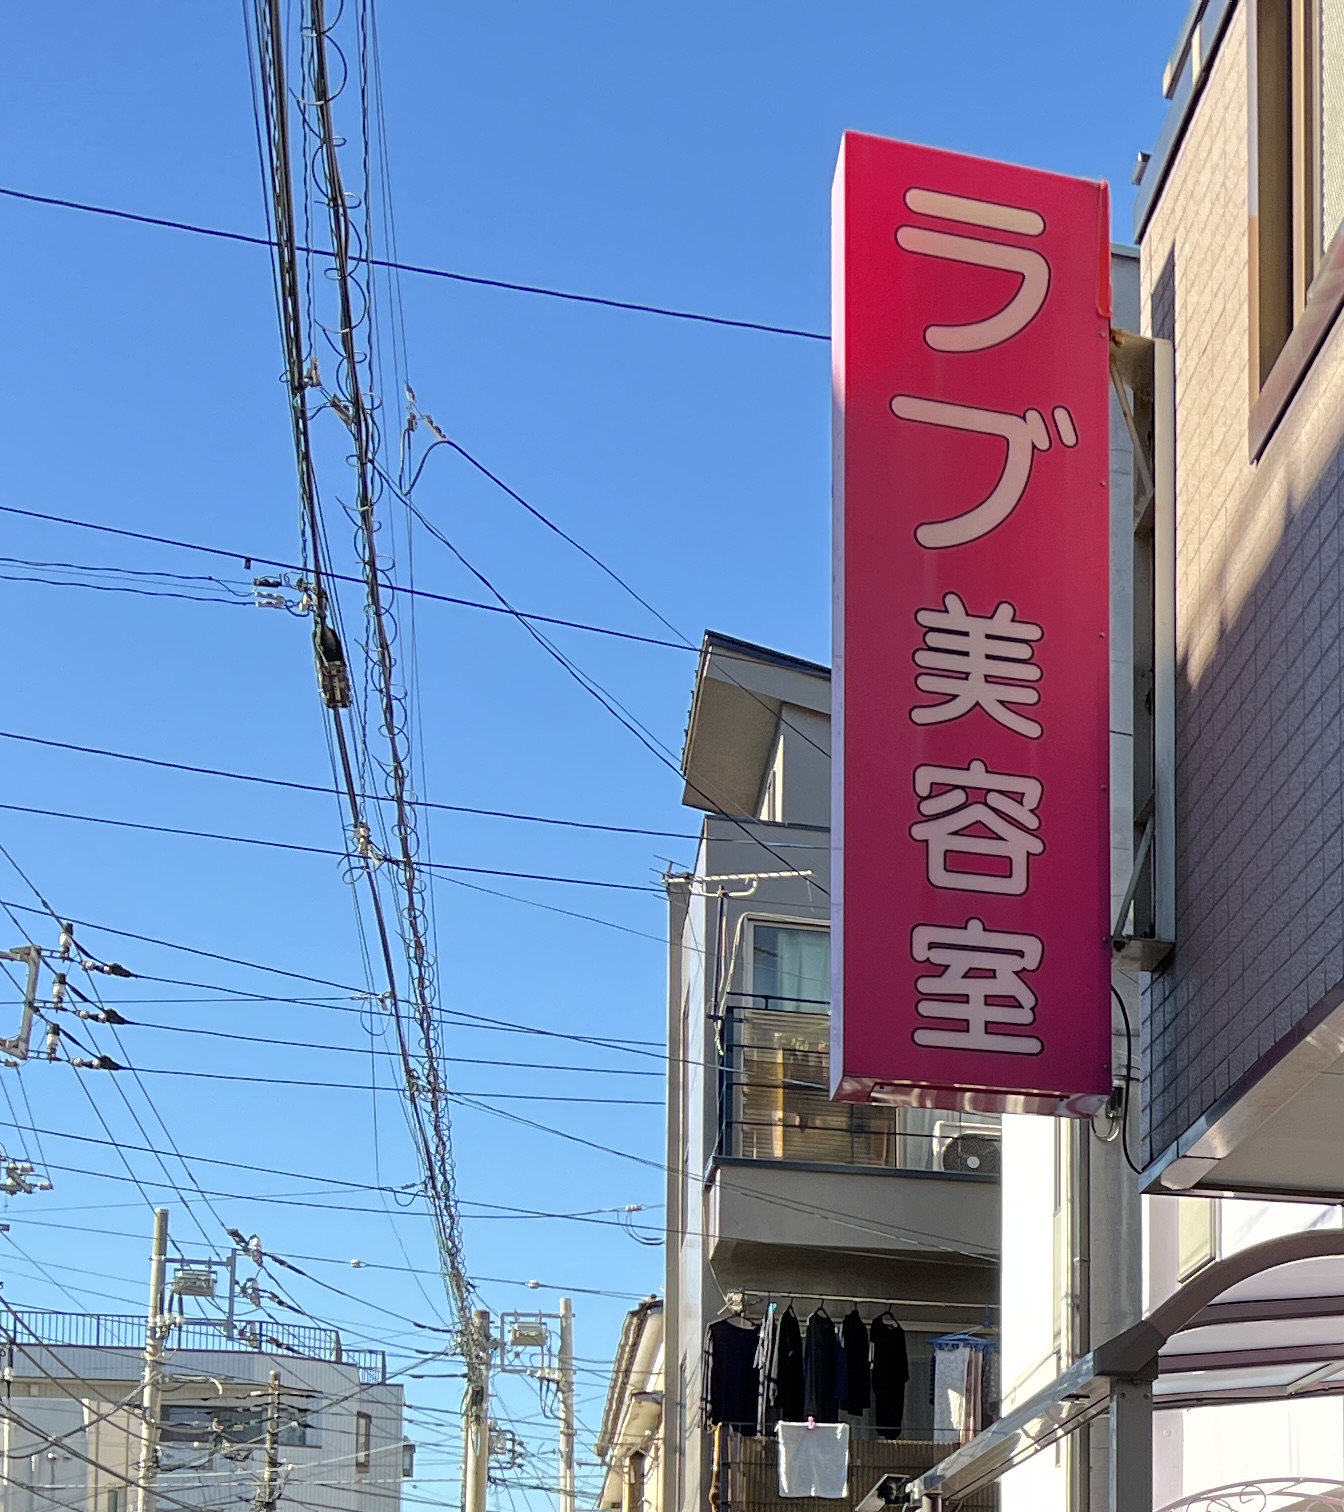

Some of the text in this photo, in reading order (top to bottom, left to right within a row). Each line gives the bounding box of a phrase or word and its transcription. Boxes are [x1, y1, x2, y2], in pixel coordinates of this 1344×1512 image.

[889, 186, 1078, 1057] ラブ美容室
